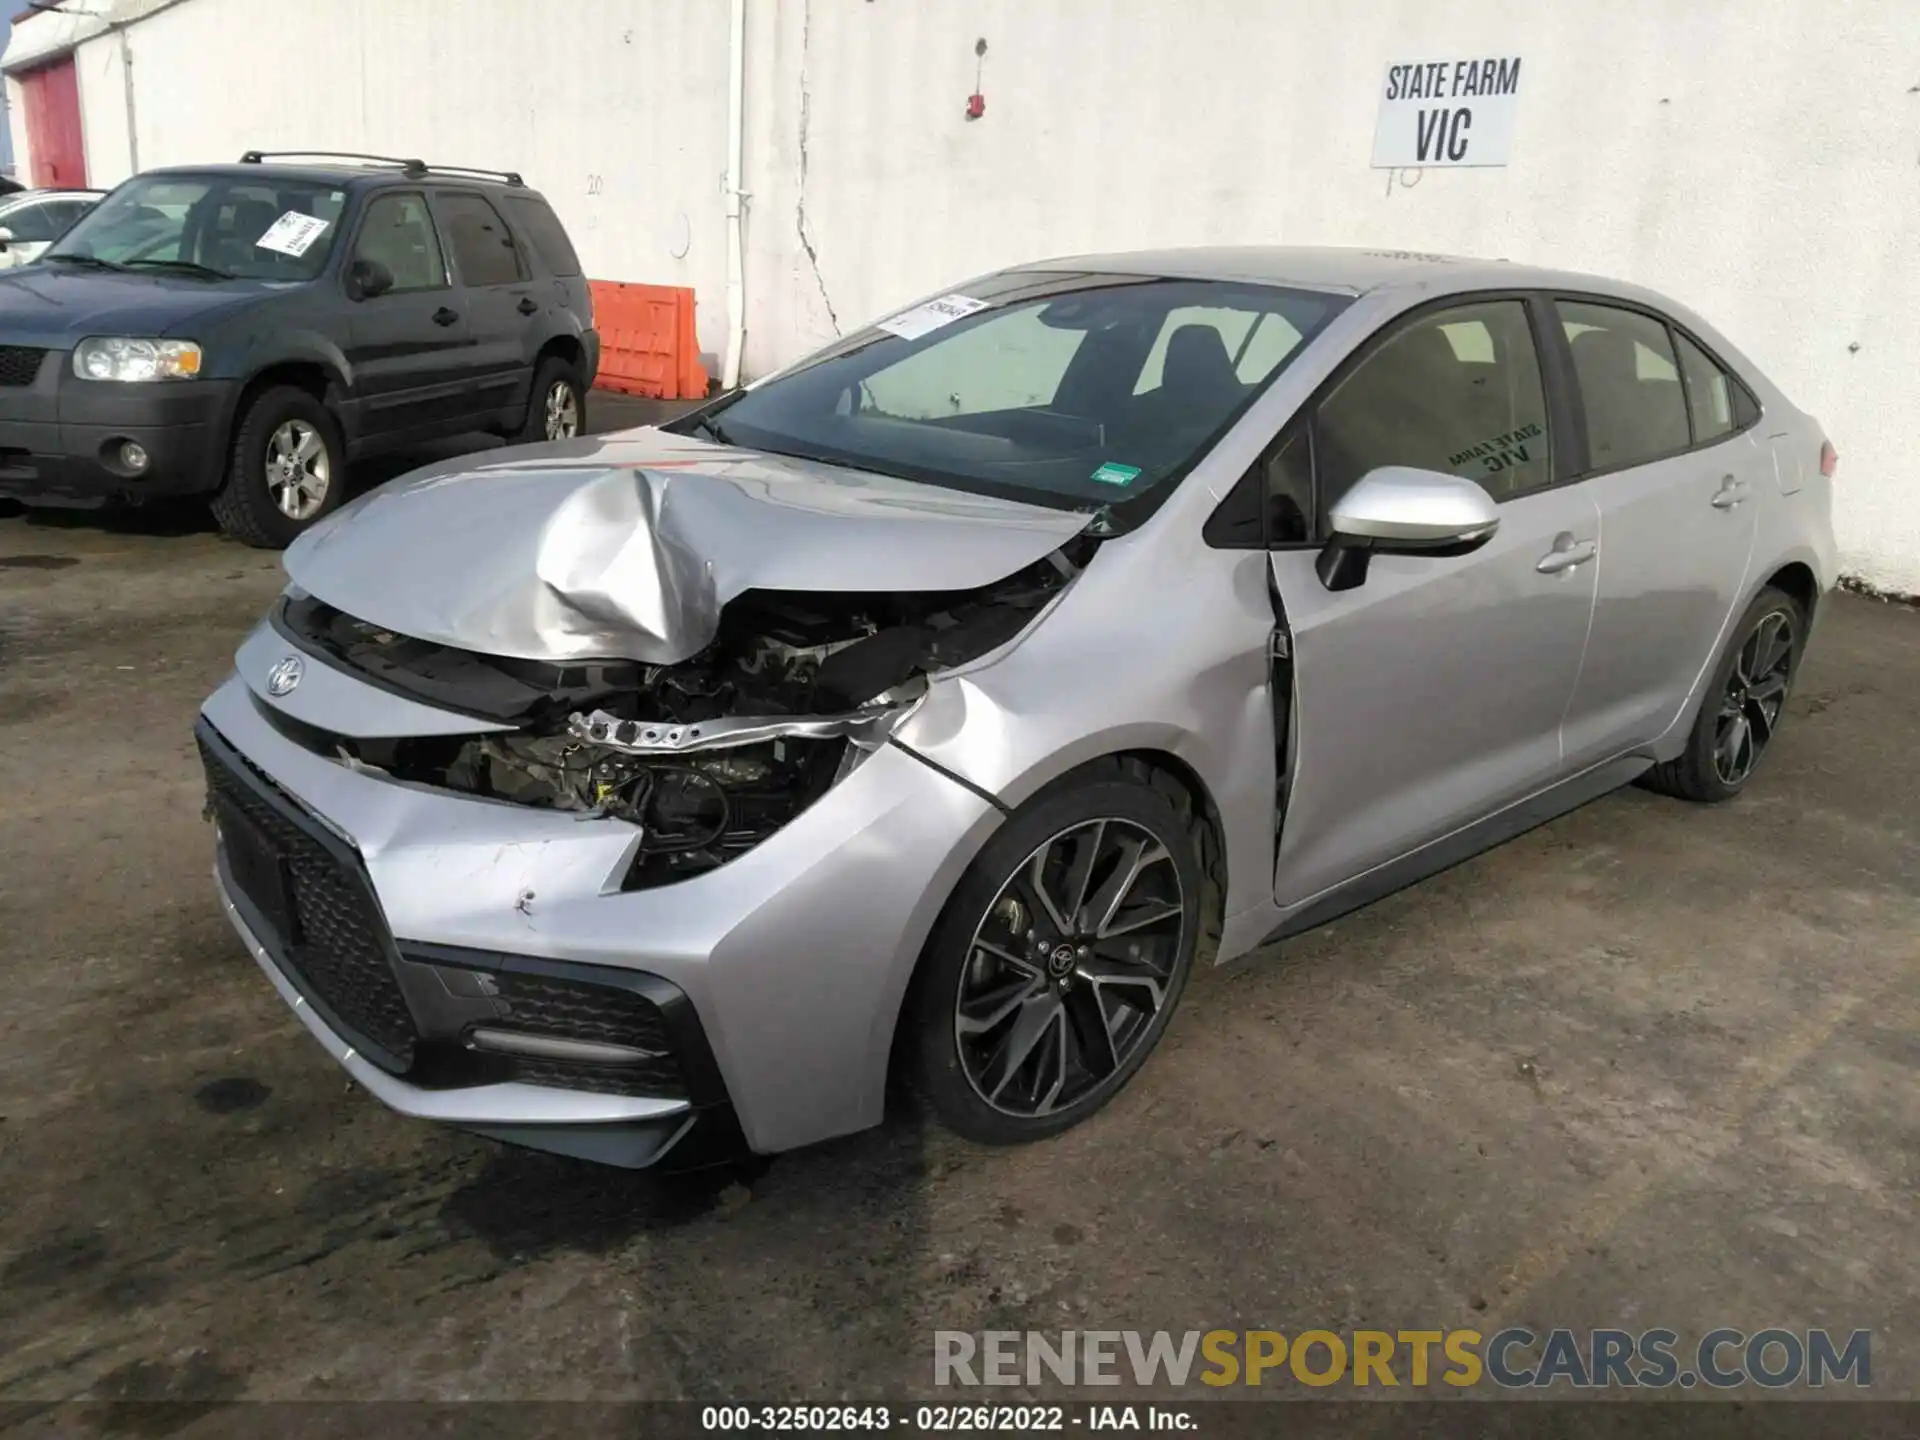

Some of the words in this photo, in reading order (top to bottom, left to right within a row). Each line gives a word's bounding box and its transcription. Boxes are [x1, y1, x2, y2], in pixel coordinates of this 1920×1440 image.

[1386, 62, 1449, 100] STATE
[1451, 57, 1521, 97] FARM
[1416, 107, 1472, 162] VIC
